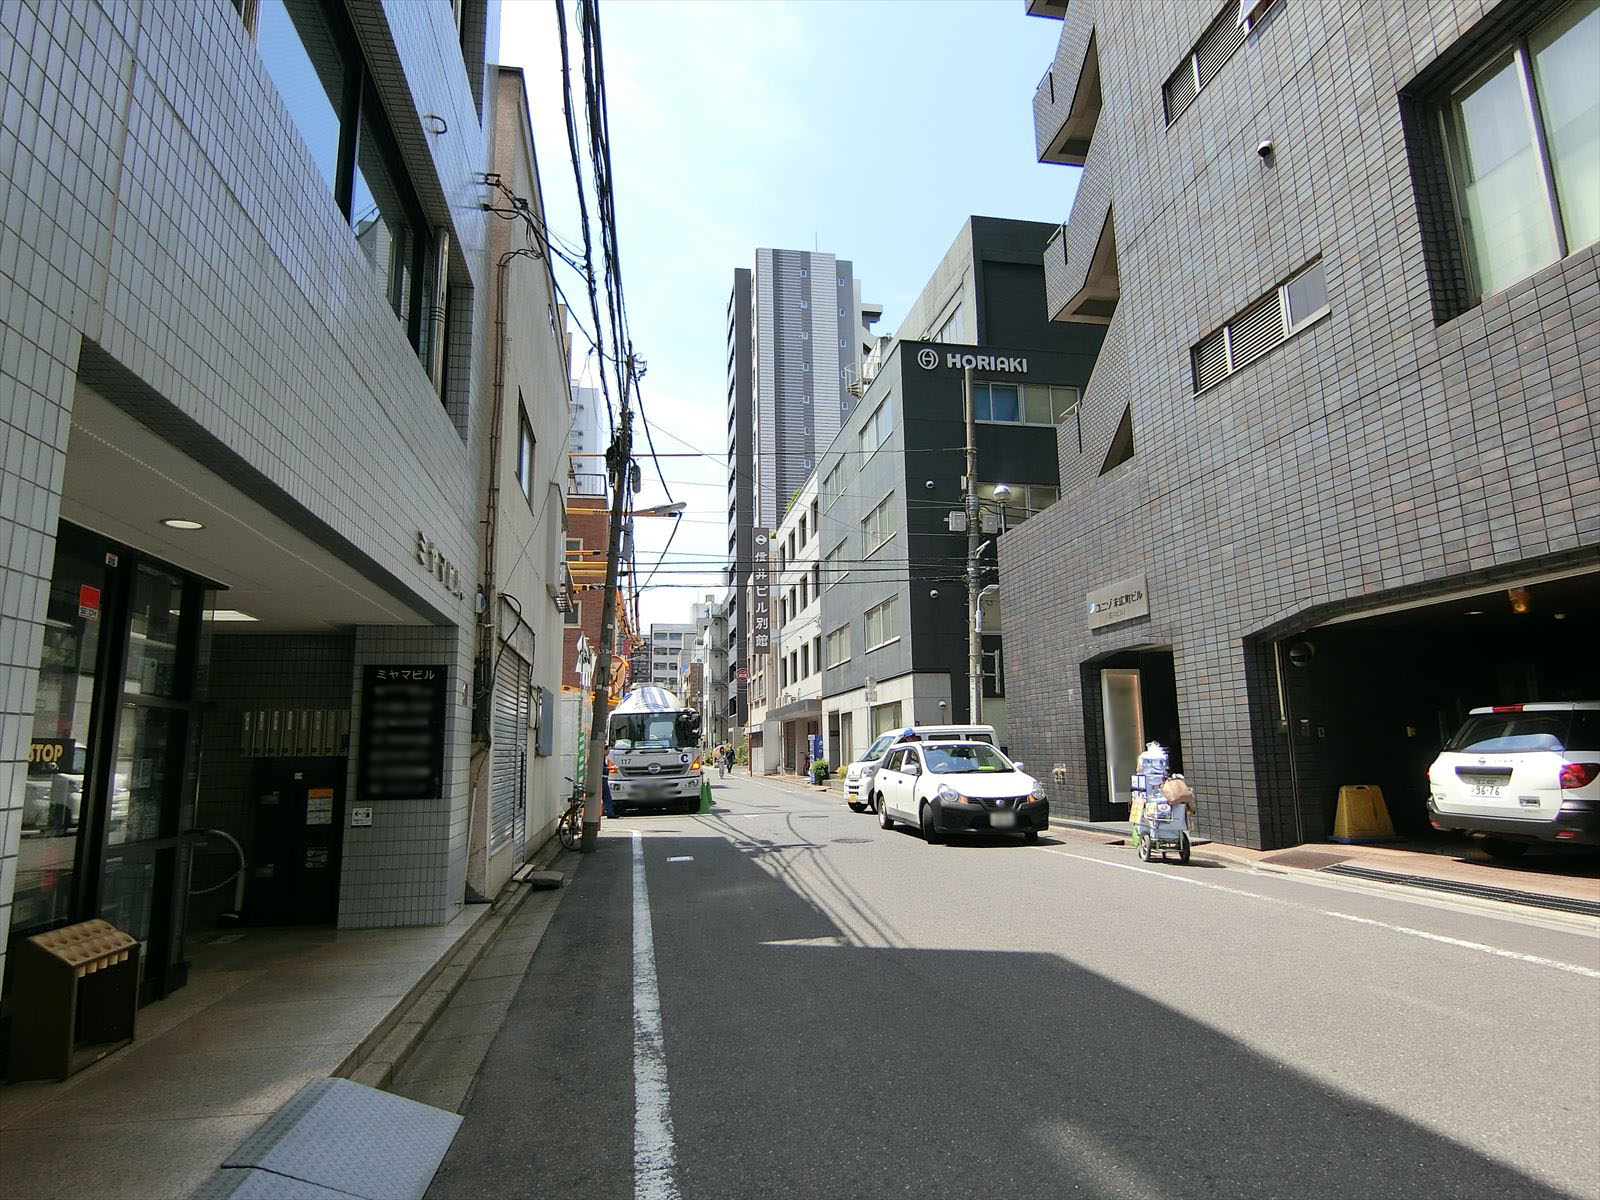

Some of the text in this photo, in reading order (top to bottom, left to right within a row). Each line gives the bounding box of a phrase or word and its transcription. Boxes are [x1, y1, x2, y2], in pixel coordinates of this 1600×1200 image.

[946, 353, 1028, 373] HORIAKI
[376, 669, 435, 680] ミヤマビル
